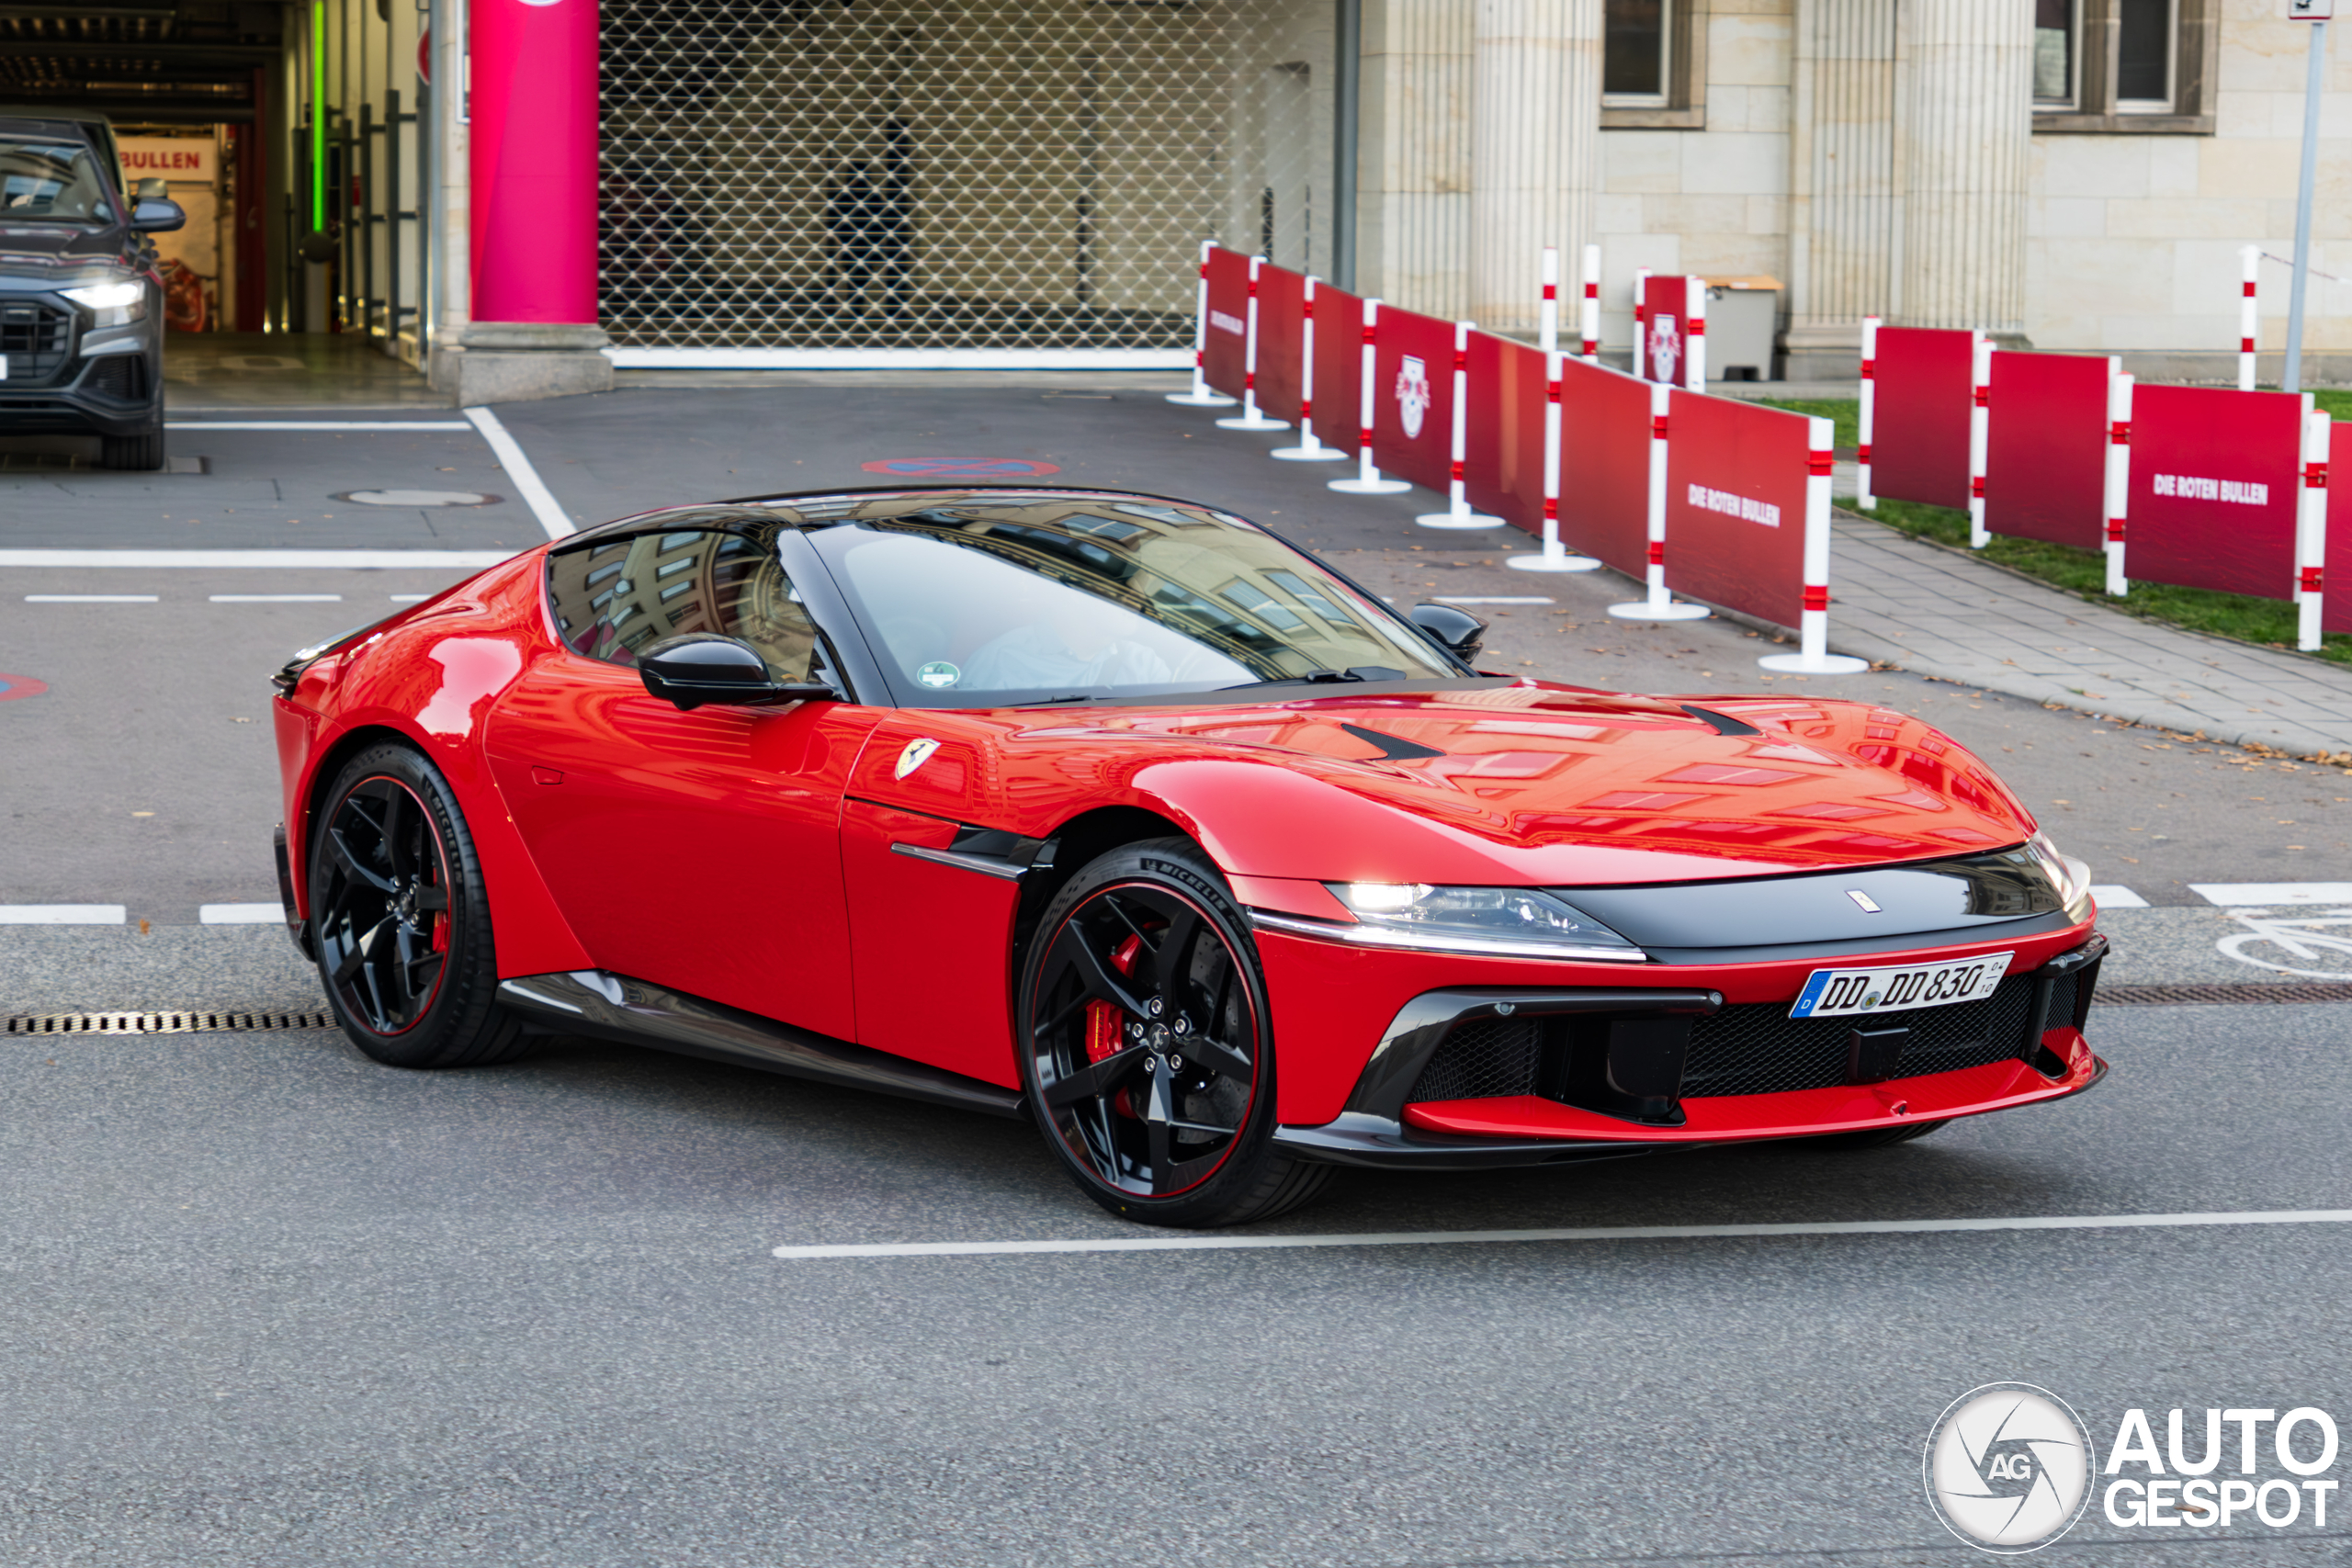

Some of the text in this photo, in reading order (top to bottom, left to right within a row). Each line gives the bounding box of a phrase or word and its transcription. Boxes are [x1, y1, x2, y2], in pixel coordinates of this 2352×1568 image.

[119, 152, 200, 169] BULLEN
[1689, 483, 1781, 528] DIE ROTEN BULLEN
[2154, 473, 2268, 505] DIE ROTEN BULLEN
[432, 796, 464, 885] MICHELIN
[1159, 863, 1227, 911] MICHELIN
[1991, 962, 2006, 971] 04
[1801, 964, 1985, 1010] D DD DD 830
[1979, 984, 1993, 993] 10
